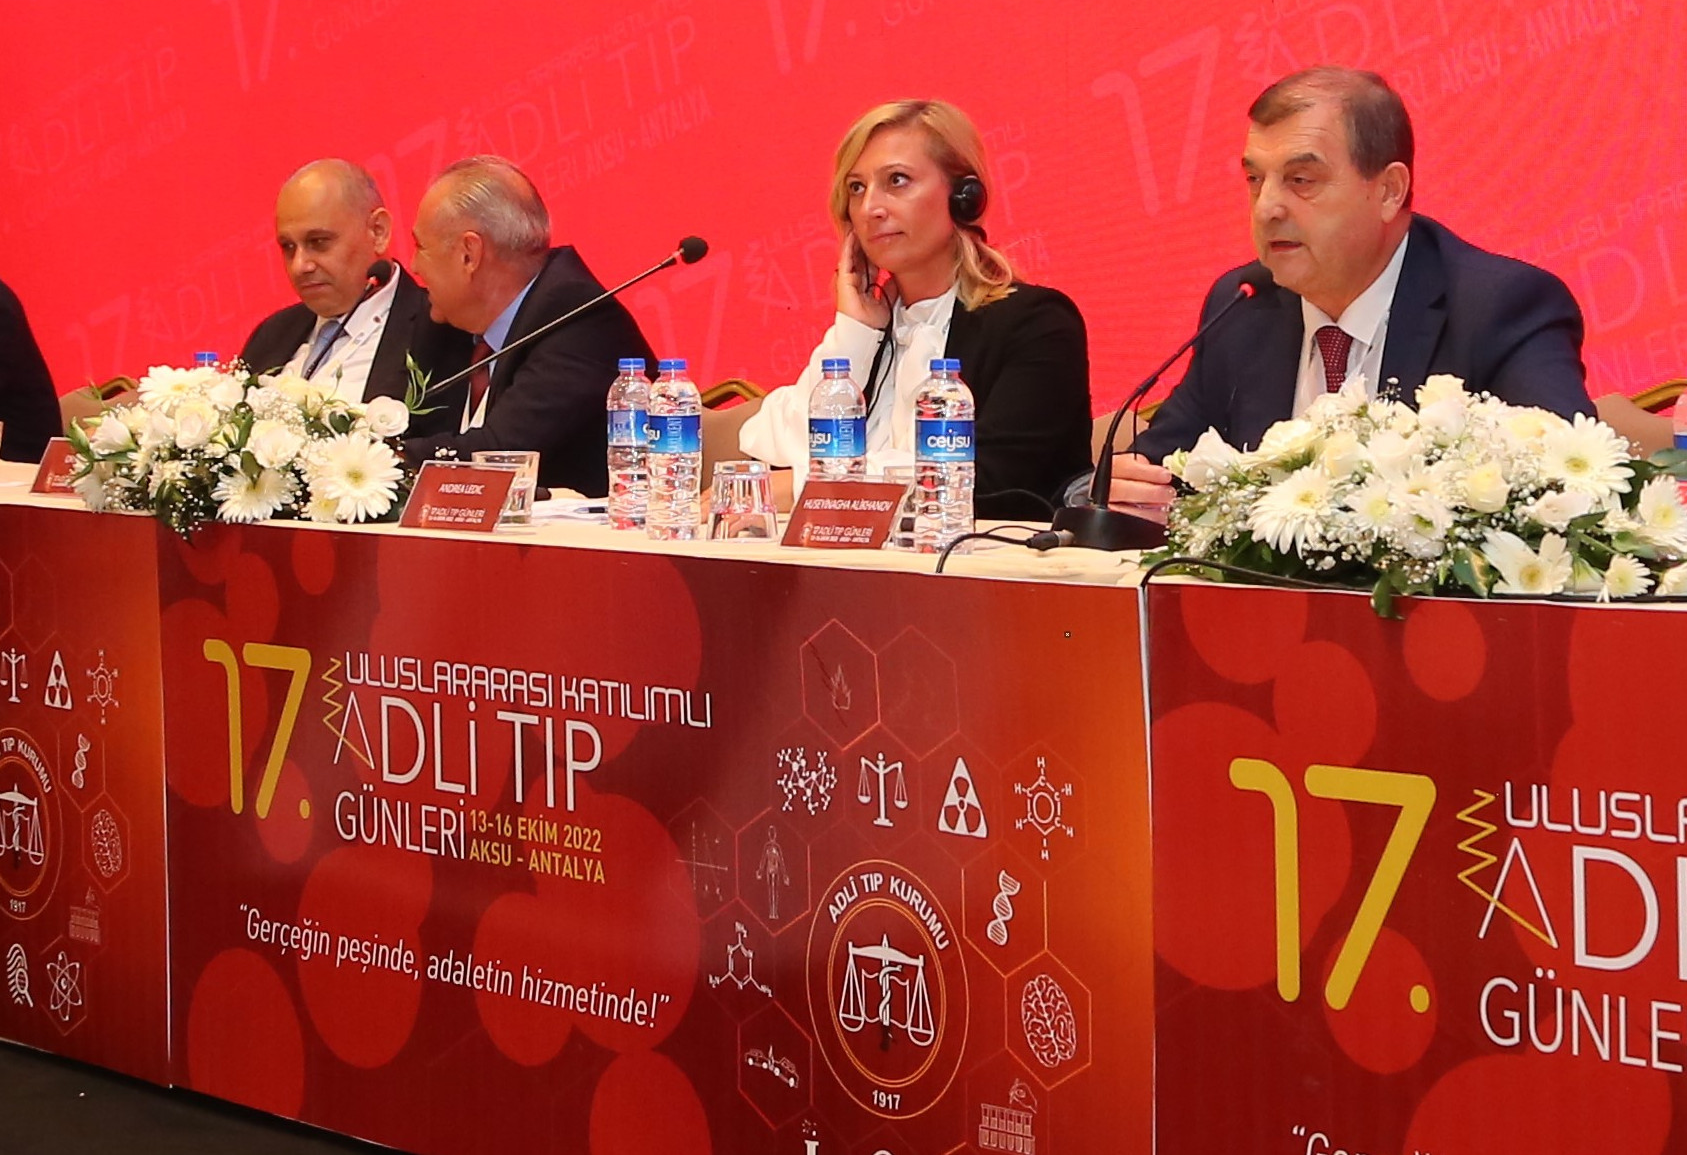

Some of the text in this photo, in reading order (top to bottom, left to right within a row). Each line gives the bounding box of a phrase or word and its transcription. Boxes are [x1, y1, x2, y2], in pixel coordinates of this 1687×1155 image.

[605, 14, 697, 110] TIP
[345, 650, 712, 728] ULUSLARARASI KATILIMLI
[1, 736, 15, 753] TIP
[16, 739, 52, 795] KURUMU
[203, 639, 311, 820] 17.
[322, 691, 603, 812] ADLİ TIP
[334, 783, 466, 861] GÜNLERİ
[469, 808, 603, 855] 13-16 EKİM 2022
[469, 841, 606, 885] AKSU ANTALYA
[1228, 756, 1432, 1014] 17.
[9, 898, 27, 914] 1917
[827, 871, 950, 952] ADLİ TIP KURUMU
[336, 933, 419, 982] peşinde,
[426, 951, 514, 998] adaletin
[871, 1088, 901, 1111] 1917
